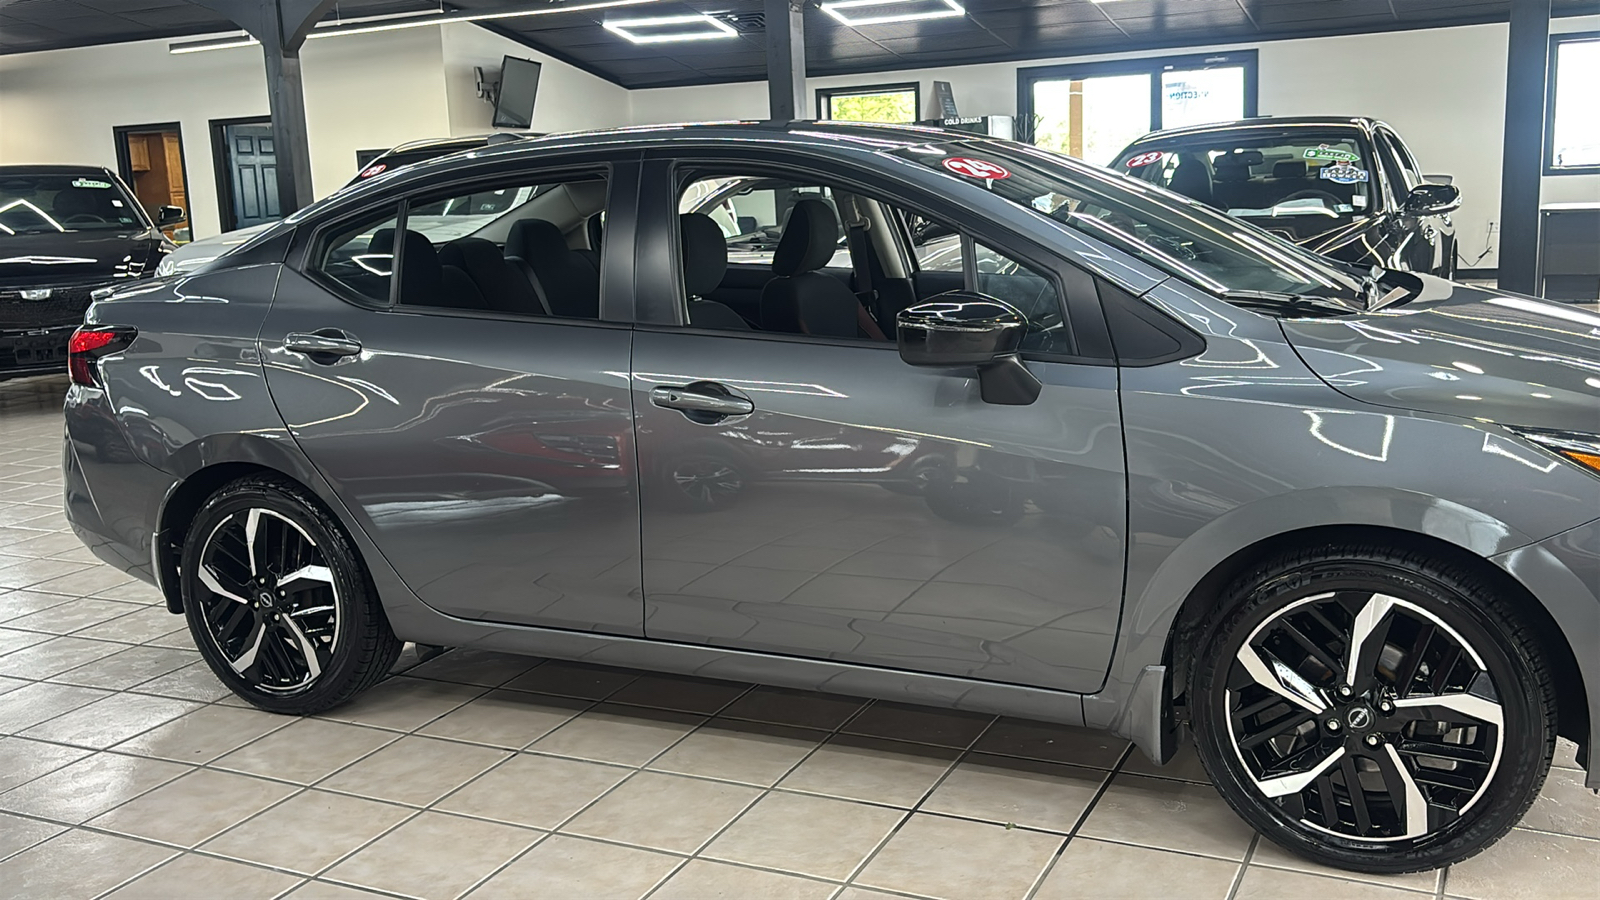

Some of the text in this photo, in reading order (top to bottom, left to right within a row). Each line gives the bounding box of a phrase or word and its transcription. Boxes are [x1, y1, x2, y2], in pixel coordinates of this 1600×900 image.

[944, 117, 959, 125] COLD
[1131, 152, 1159, 166] 23
[948, 158, 1003, 177] 24
